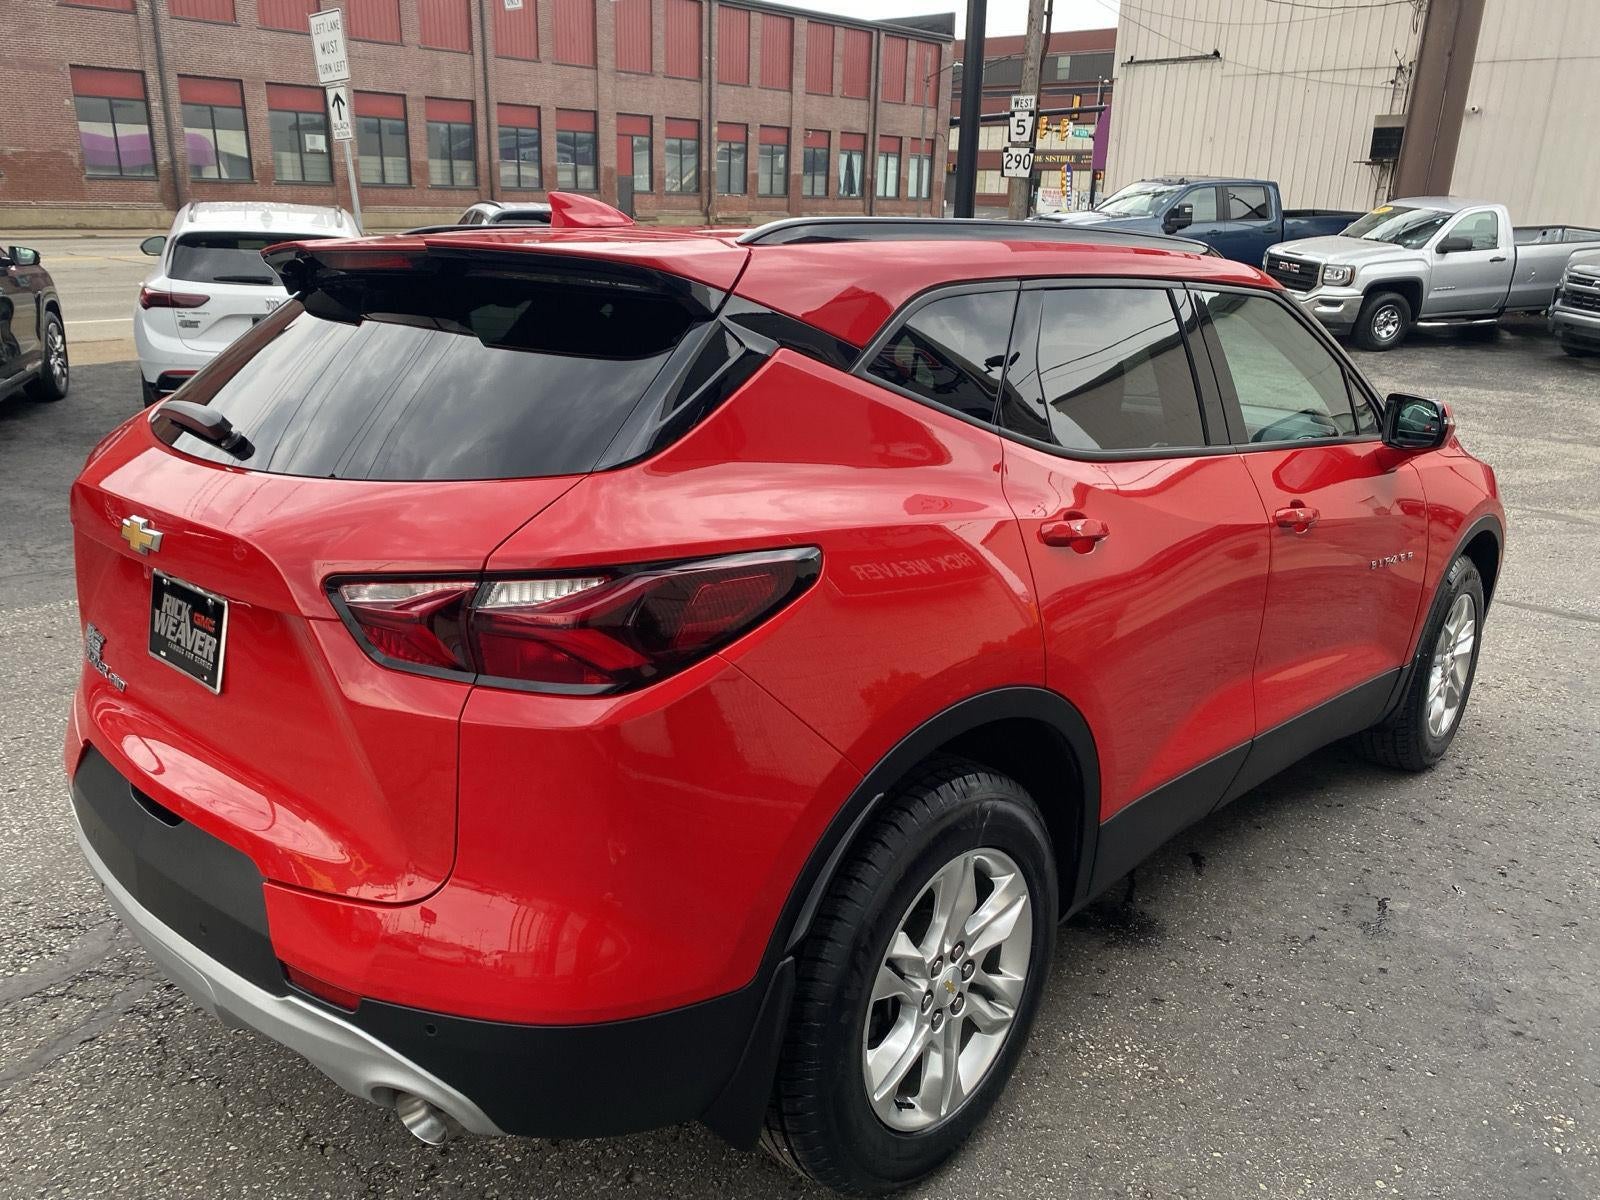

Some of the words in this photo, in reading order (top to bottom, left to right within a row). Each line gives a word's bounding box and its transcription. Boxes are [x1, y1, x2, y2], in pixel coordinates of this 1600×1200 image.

[313, 22, 326, 36] LEFT
[326, 19, 341, 32] LANE
[320, 39, 339, 56] MUST
[319, 63, 333, 76] TURN
[333, 60, 347, 73] LEFT
[1013, 97, 1034, 109] WEST
[1015, 119, 1026, 136] 5
[1004, 153, 1031, 170] 290
[1279, 261, 1300, 273] GMC
[162, 593, 192, 624] RICK
[194, 612, 215, 632] GMC
[154, 608, 217, 663] WEAVER
